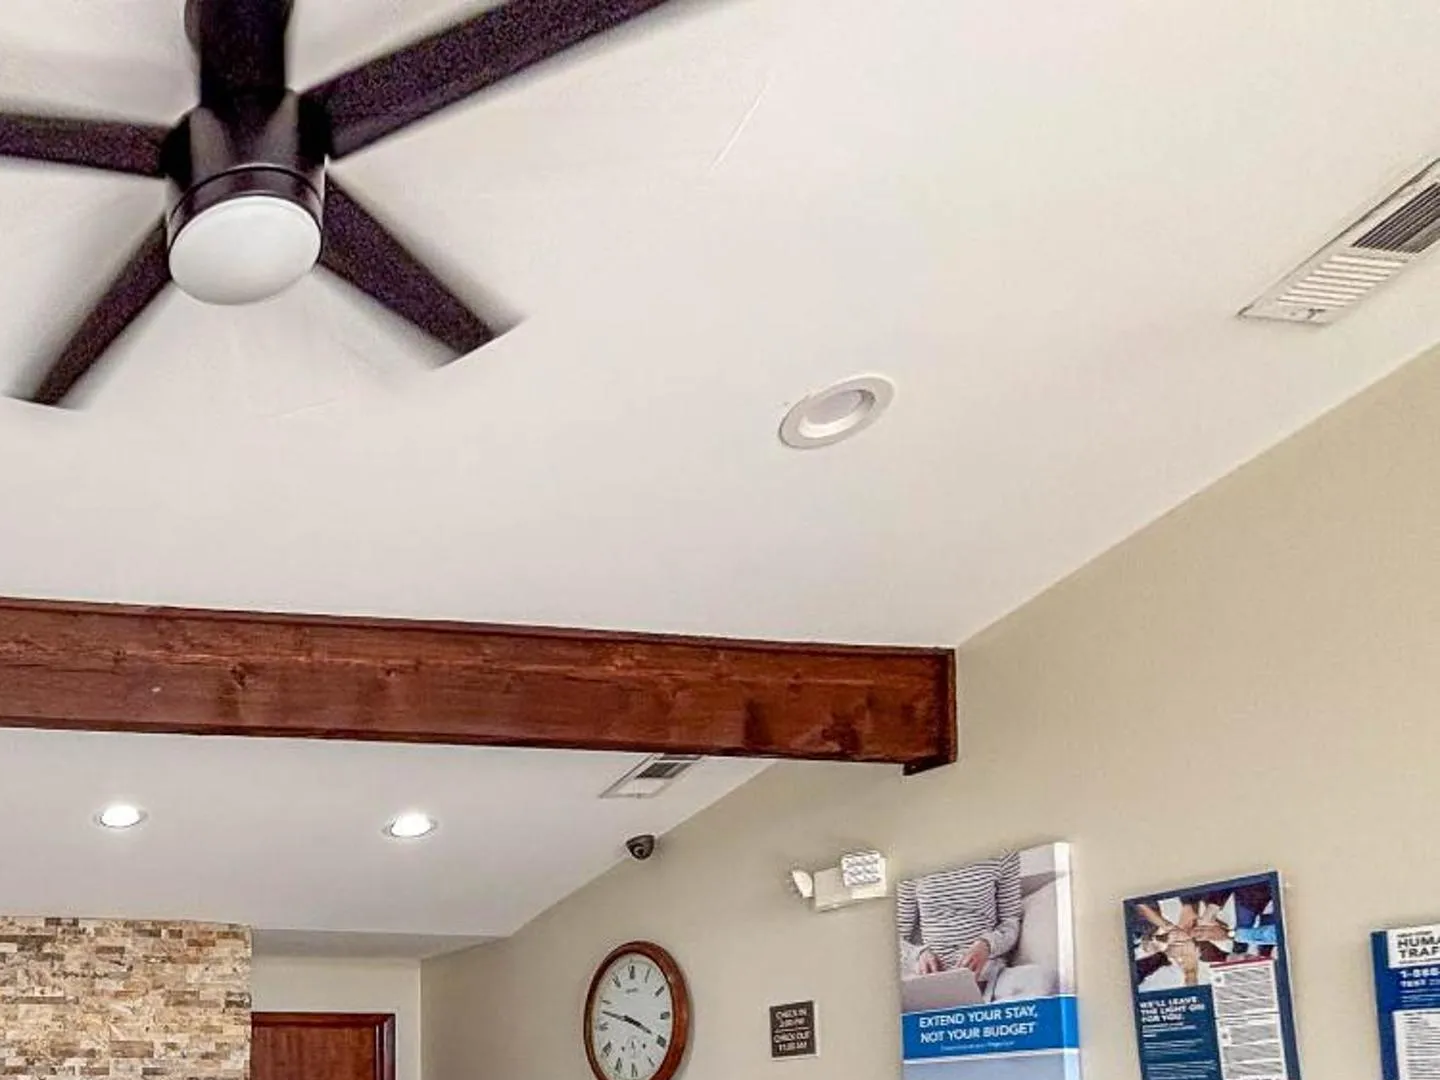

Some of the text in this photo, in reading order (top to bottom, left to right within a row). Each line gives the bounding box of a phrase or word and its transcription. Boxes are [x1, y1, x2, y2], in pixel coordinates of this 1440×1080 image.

[1397, 936, 1440, 948] HUM
[919, 1004, 1038, 1028] EXTEND YOUR STAY,
[920, 1022, 1036, 1043] NOT YOUR BUDGET
